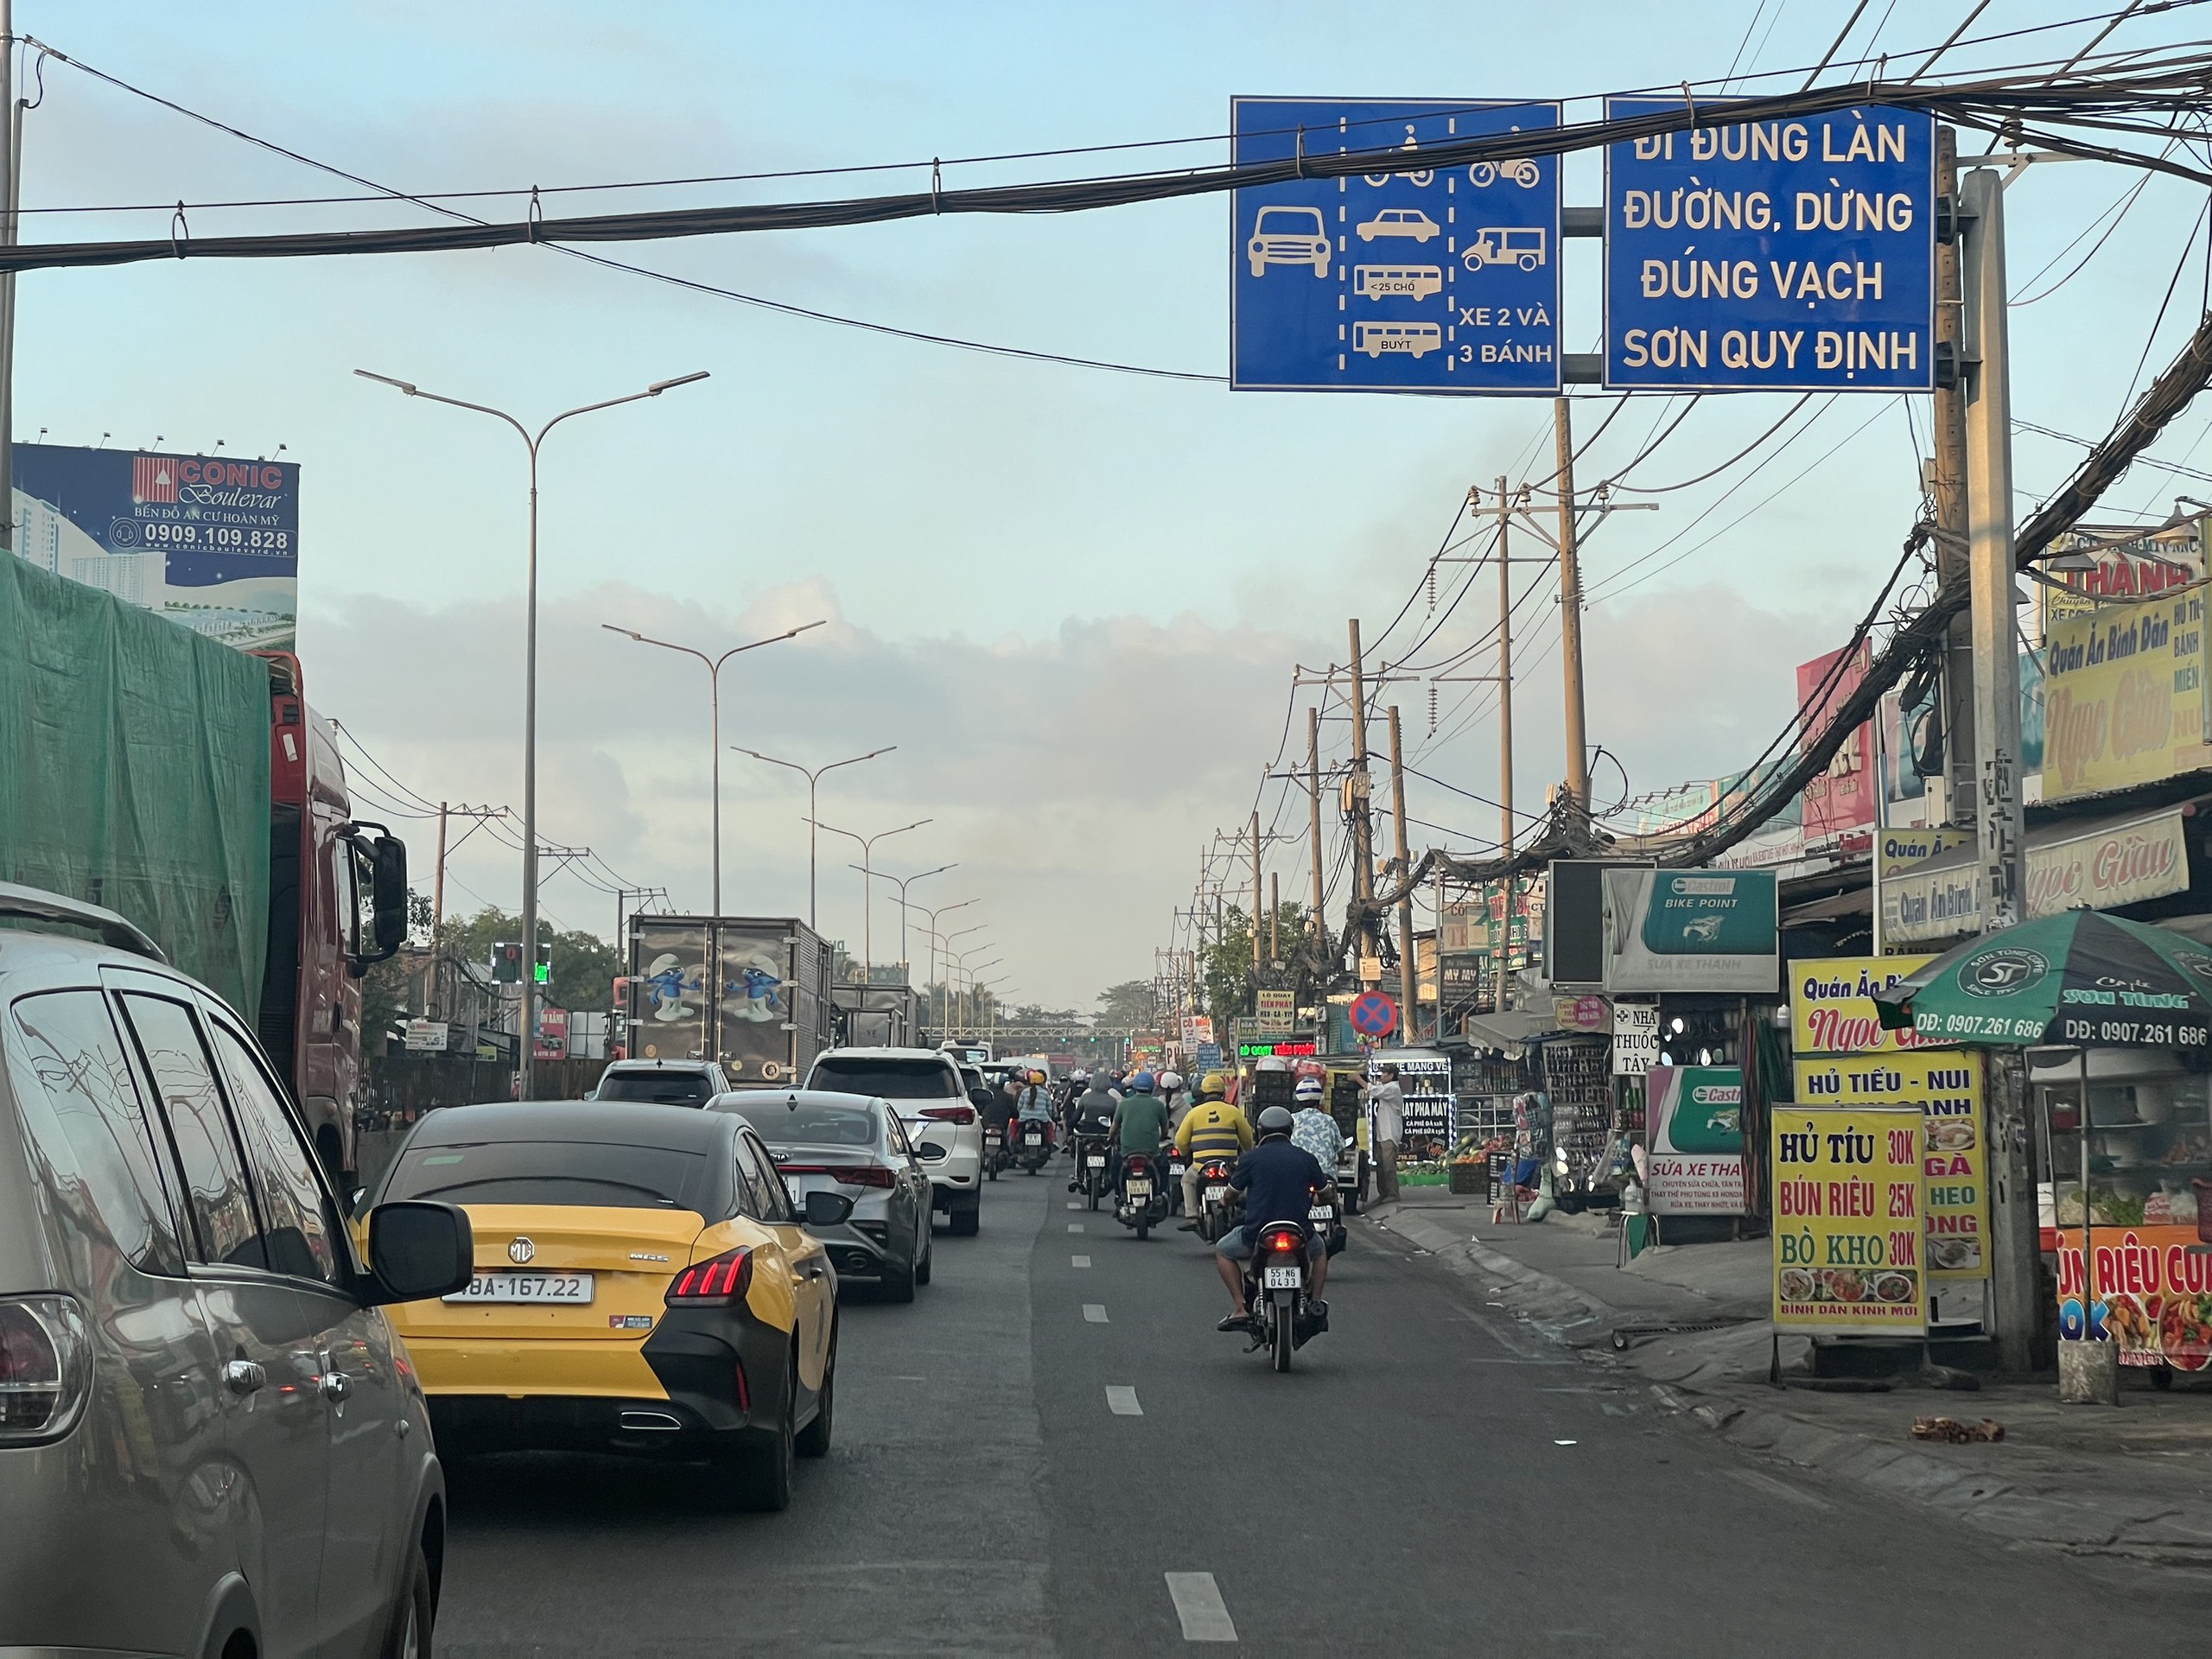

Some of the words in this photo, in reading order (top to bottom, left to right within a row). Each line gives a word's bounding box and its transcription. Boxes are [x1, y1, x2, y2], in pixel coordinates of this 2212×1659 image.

[1822, 110, 1905, 162] LÀN
[1623, 176, 1782, 233] ĐƯỜNG,
[1796, 177, 1913, 232] DỪNG
[1393, 279, 1416, 292] CHỖ
[1640, 245, 1759, 299] ĐÚNG
[1770, 261, 1883, 309] VẠCH
[1459, 308, 1491, 327] XE
[1497, 308, 1510, 327] 2
[1517, 302, 1551, 327] VÀ
[1381, 337, 1412, 350] BUÝT
[1459, 345, 1473, 363] 3
[1481, 339, 1553, 363] BÁNH
[1623, 325, 1707, 368] SƠN
[1720, 330, 1805, 369] QUY
[1815, 331, 1916, 379] ĐỊNH
[179, 460, 283, 490] CONIC
[135, 504, 160, 518] BẾN
[203, 511, 221, 521] CƯ
[223, 512, 257, 524] HOÀN
[261, 516, 280, 526] MỸ
[144, 523, 288, 550] 0909.109.828
[2050, 635, 2084, 678] Quán
[2086, 620, 2106, 667] Ăn
[2140, 612, 2169, 652] Dân
[1885, 838, 1927, 859] Quán
[1664, 899, 1694, 908] BIKE
[1699, 899, 1738, 908] POINT
[1803, 976, 1852, 1001] Quán
[1856, 969, 1880, 997] Ăn
[1632, 1007, 1656, 1025] NHÀ
[1916, 1013, 1942, 1032] DĐ:
[1947, 1014, 2012, 1035] 0907.261
[2014, 1019, 2044, 1039] 686
[1614, 1026, 1659, 1050] THUỐC
[2065, 1019, 2096, 1040] DĐ:
[2101, 1021, 2173, 1044] 0907.261
[2178, 1026, 2208, 1046] 686
[1407, 1062, 1434, 1071] MANG
[1622, 1052, 1649, 1072] TÂY
[1808, 1068, 1840, 1095] HỦ
[1848, 1066, 1901, 1093] TIẾU
[1927, 1070, 1970, 1090] NUI
[1708, 1088, 1741, 1102] Castr
[1779, 1121, 1819, 1163] HỦ
[1827, 1125, 1874, 1164] TÍU
[1887, 1130, 1915, 1165] 30K
[1651, 1159, 1682, 1176] SỬA
[1687, 1163, 1707, 1176] XE
[1711, 1163, 1741, 1176] THA
[1924, 1153, 1973, 1177] GÀ
[1779, 1174, 1821, 1217] BÚN
[1828, 1174, 1875, 1217] RIÊU
[1889, 1183, 1915, 1217] 25K
[1930, 1186, 1976, 1205] HEO
[510, 1242, 532, 1262] MG
[1780, 1225, 1815, 1265] BÒ
[1826, 1235, 1885, 1266] KHO
[1889, 1231, 1916, 1267] 30K
[2096, 1231, 2160, 1294] RIÊU
[462, 1277, 581, 1297] 8A-167.22
[1270, 1278, 1296, 1287] 0433
